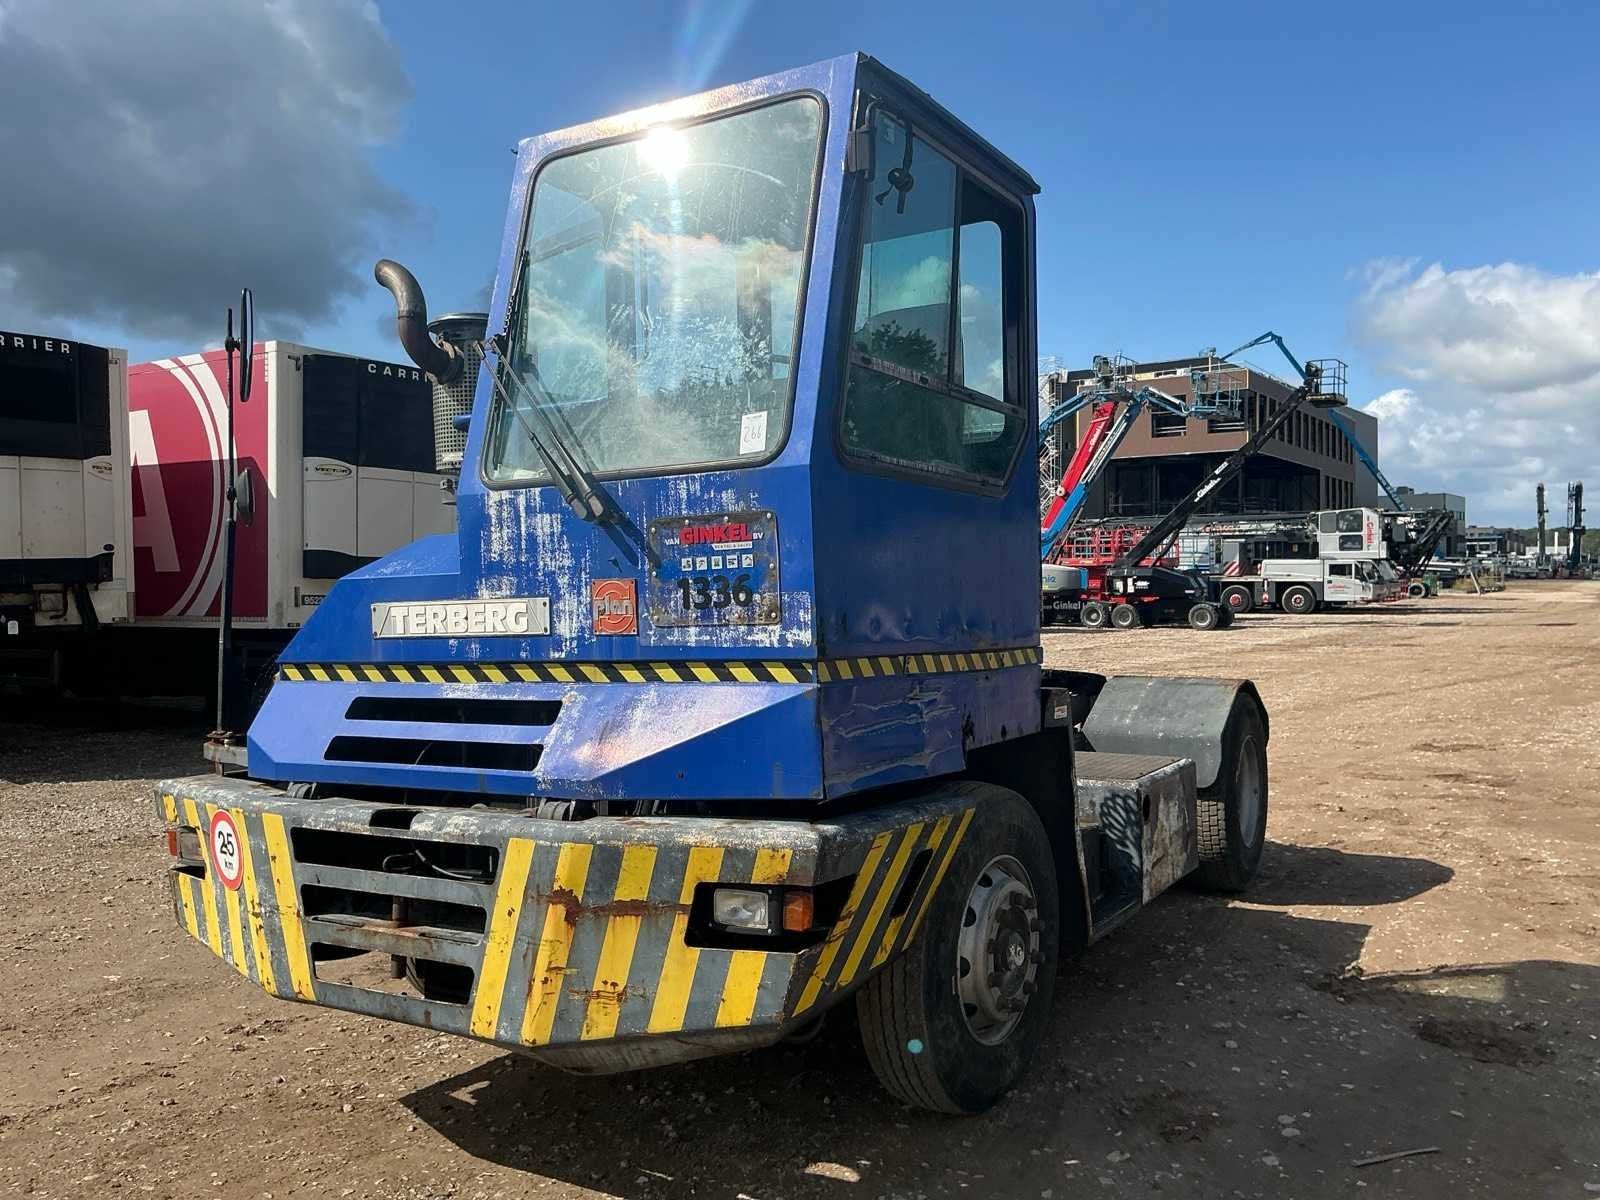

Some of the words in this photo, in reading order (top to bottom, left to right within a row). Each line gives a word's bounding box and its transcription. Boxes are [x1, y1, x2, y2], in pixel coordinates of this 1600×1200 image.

[664, 537, 680, 546] VAN
[680, 522, 753, 545] GINKEL
[753, 532, 764, 540] BV
[677, 574, 753, 611] 1336
[1053, 600, 1081, 610] Ginkel
[391, 602, 529, 634] TERBERG
[217, 830, 235, 857] 25
